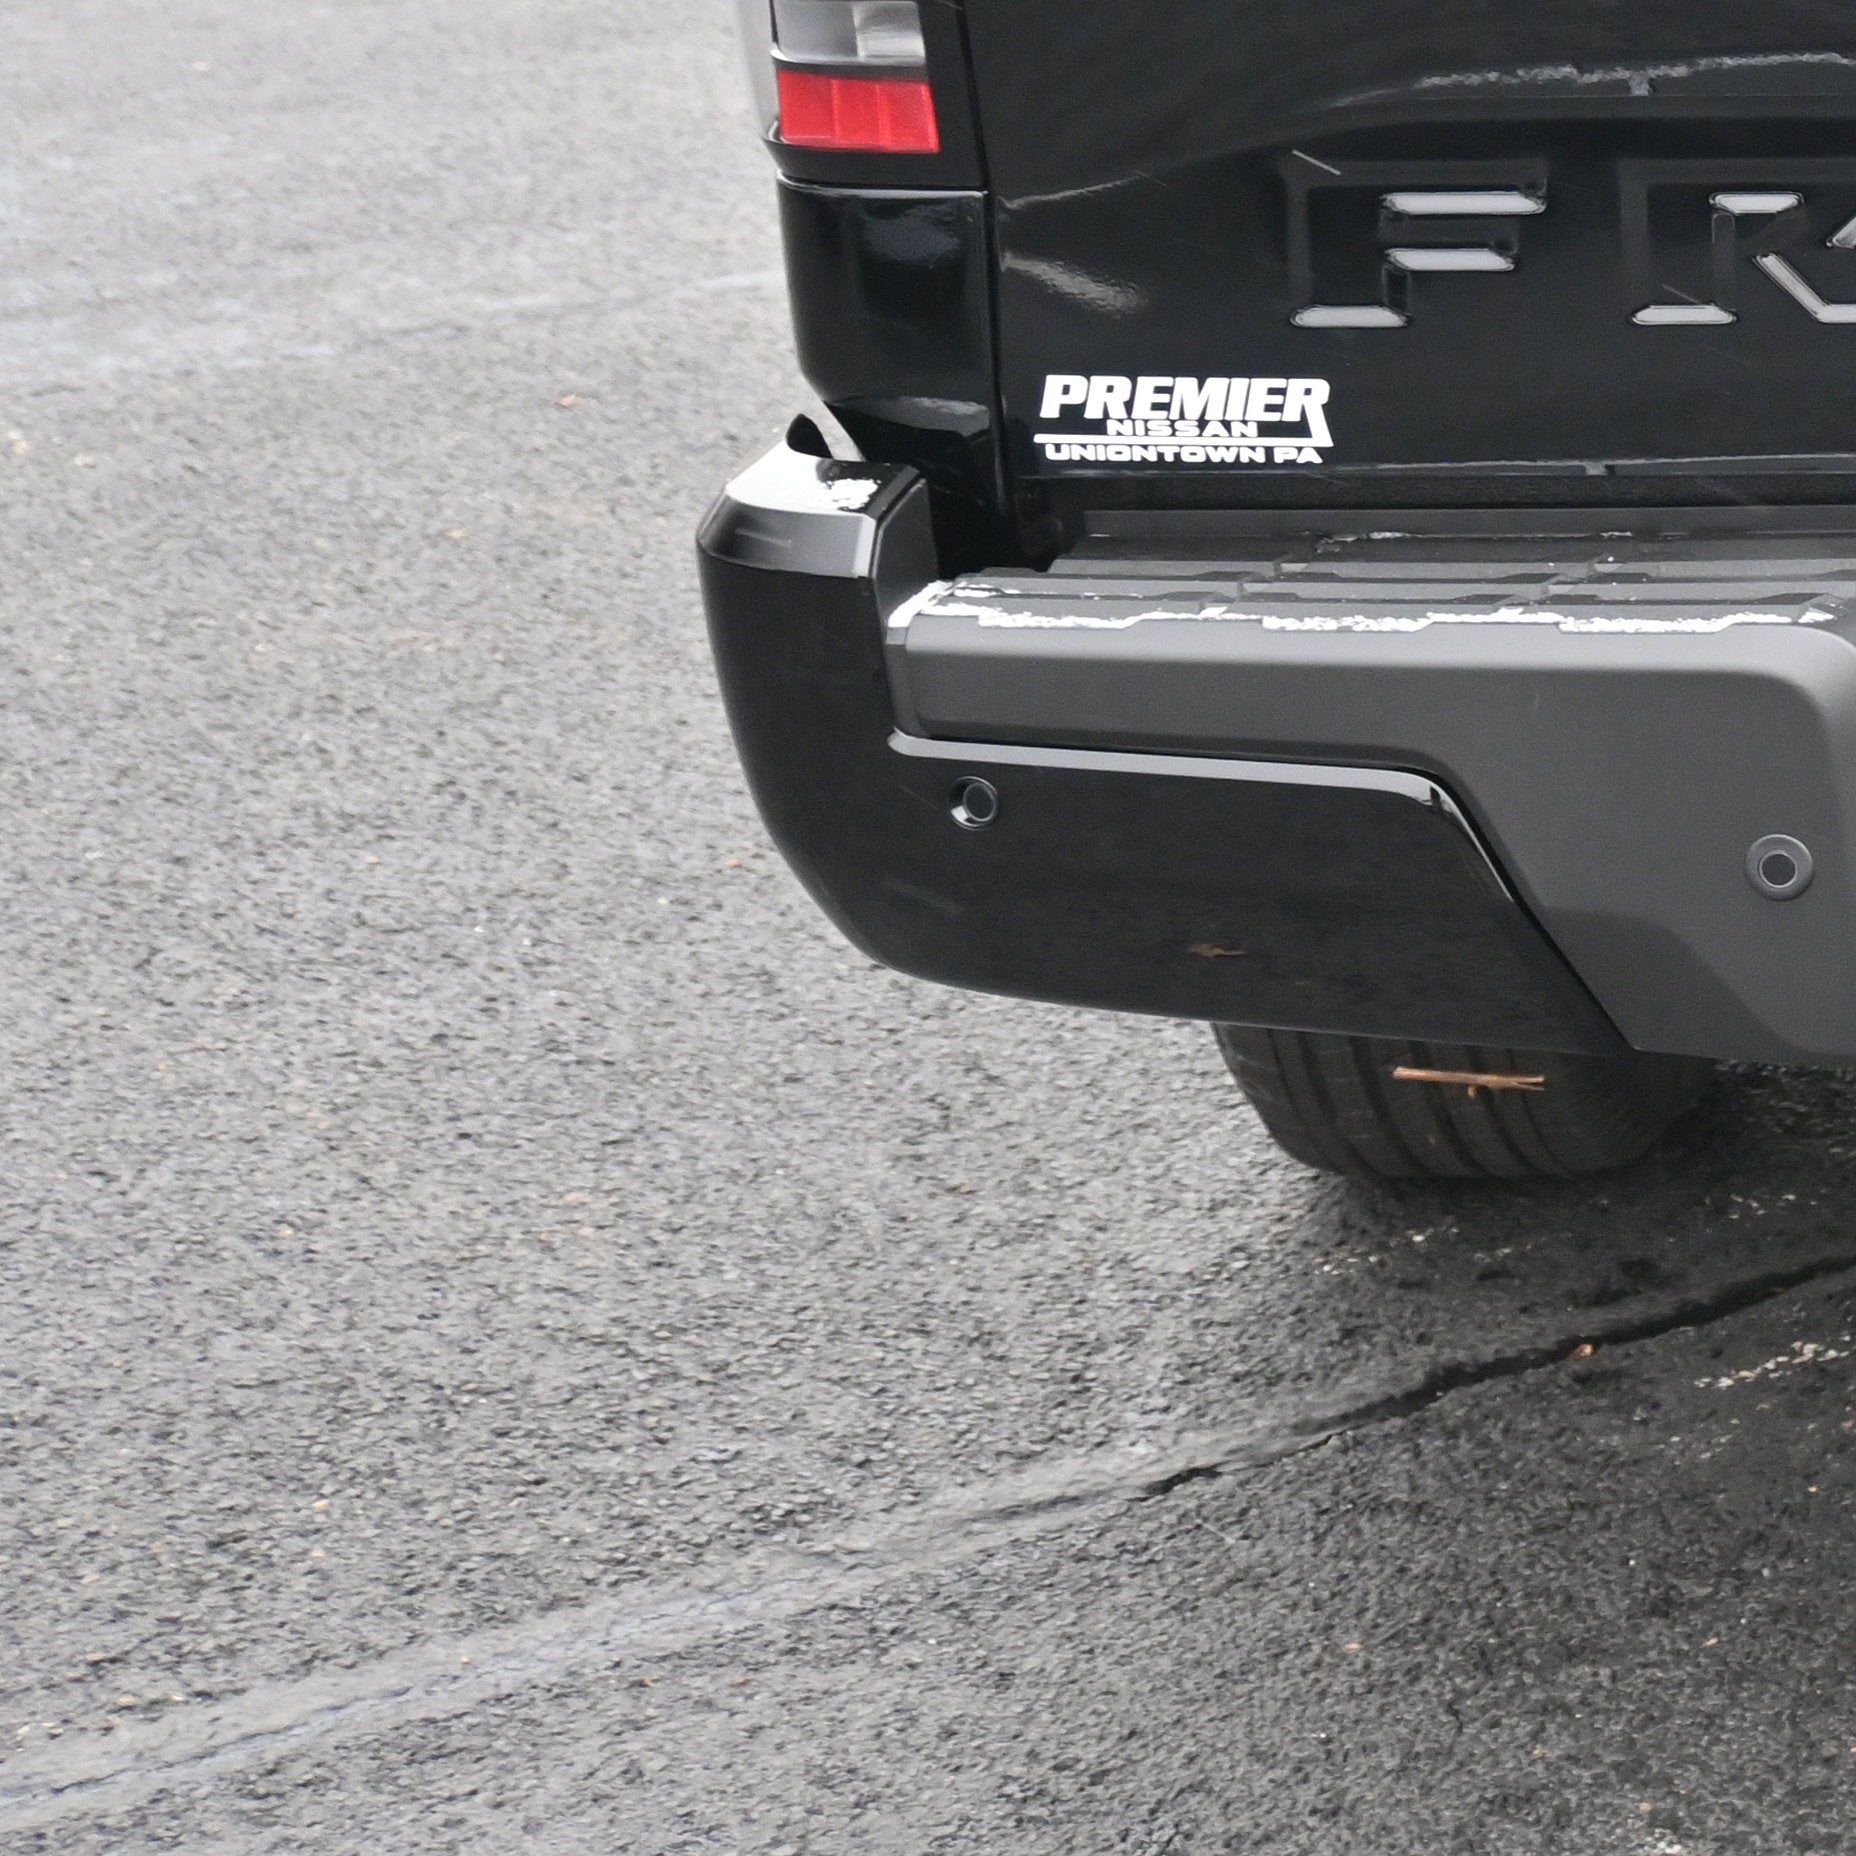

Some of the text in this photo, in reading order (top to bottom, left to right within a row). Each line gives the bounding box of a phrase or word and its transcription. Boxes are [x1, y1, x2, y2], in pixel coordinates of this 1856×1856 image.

[1039, 373, 1334, 424] PREMIER
[1105, 418, 1259, 439] NISSAN
[1044, 443, 1324, 465] UNIONTOWN PA
